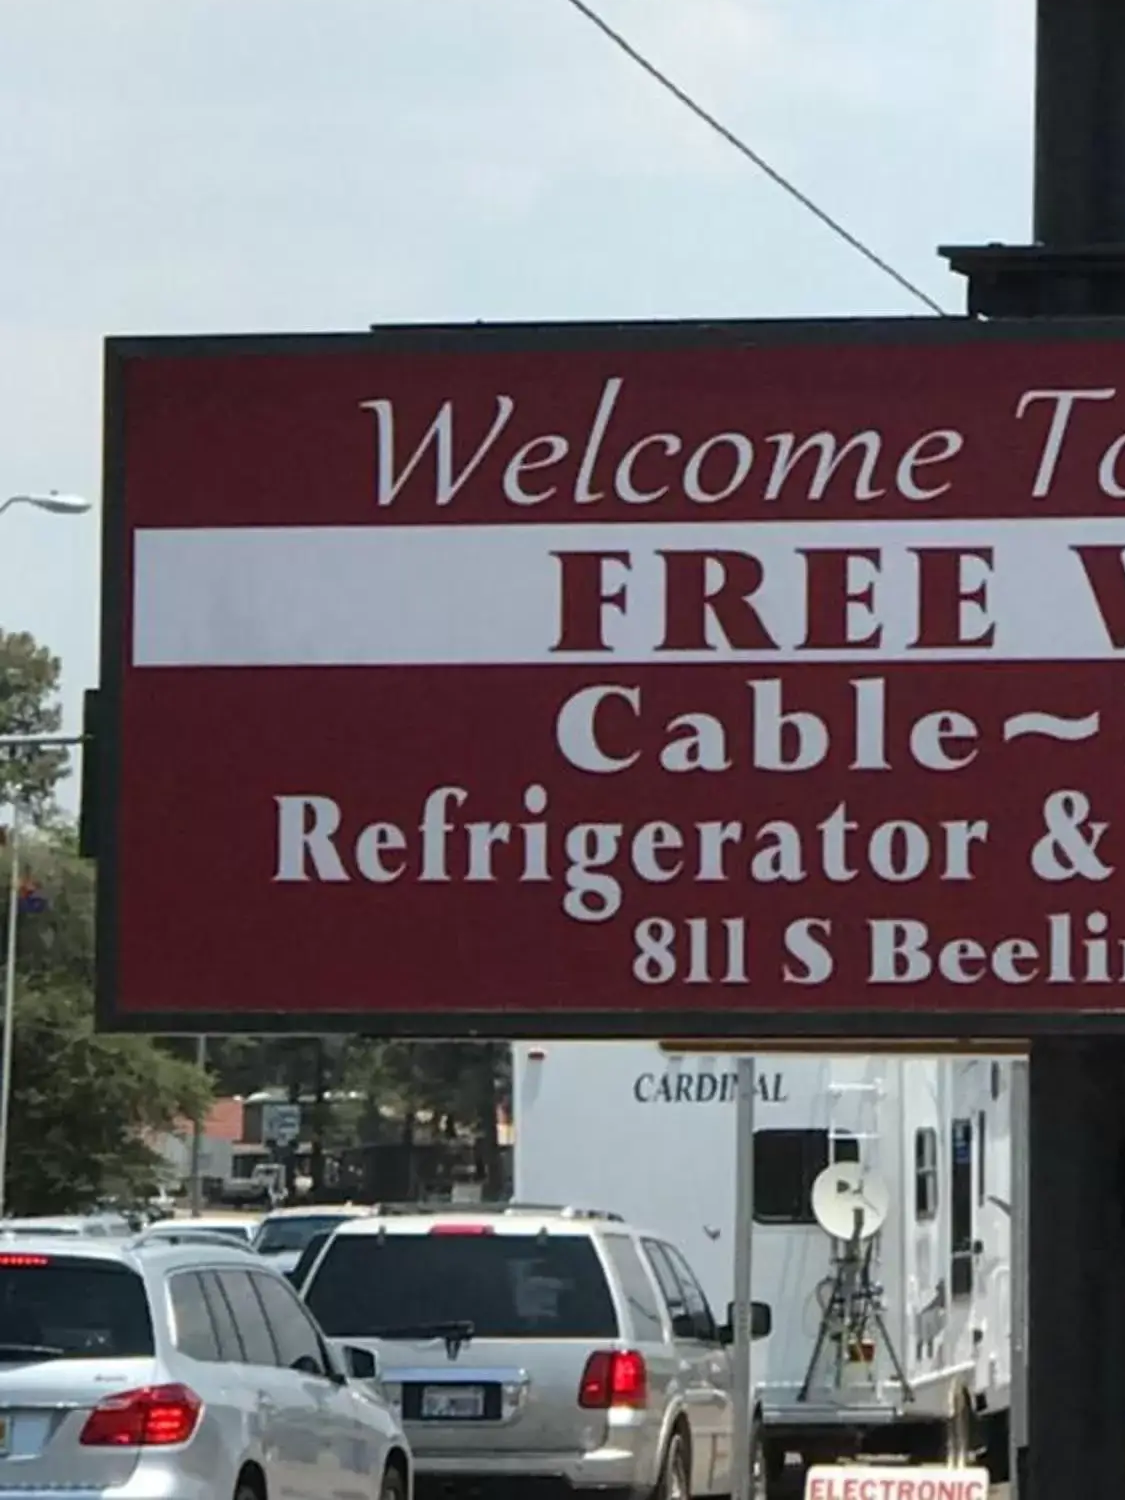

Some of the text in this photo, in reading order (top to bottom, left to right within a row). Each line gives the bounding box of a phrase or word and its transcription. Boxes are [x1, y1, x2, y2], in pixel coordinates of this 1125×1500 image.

[361, 377, 963, 505] Welcome
[548, 550, 996, 653] FREE
[273, 784, 989, 926] Refrigerator
[1031, 789, 1114, 882] &
[632, 916, 748, 984] 811
[783, 917, 833, 984] S
[810, 1478, 983, 1500] ELECTRONIC
